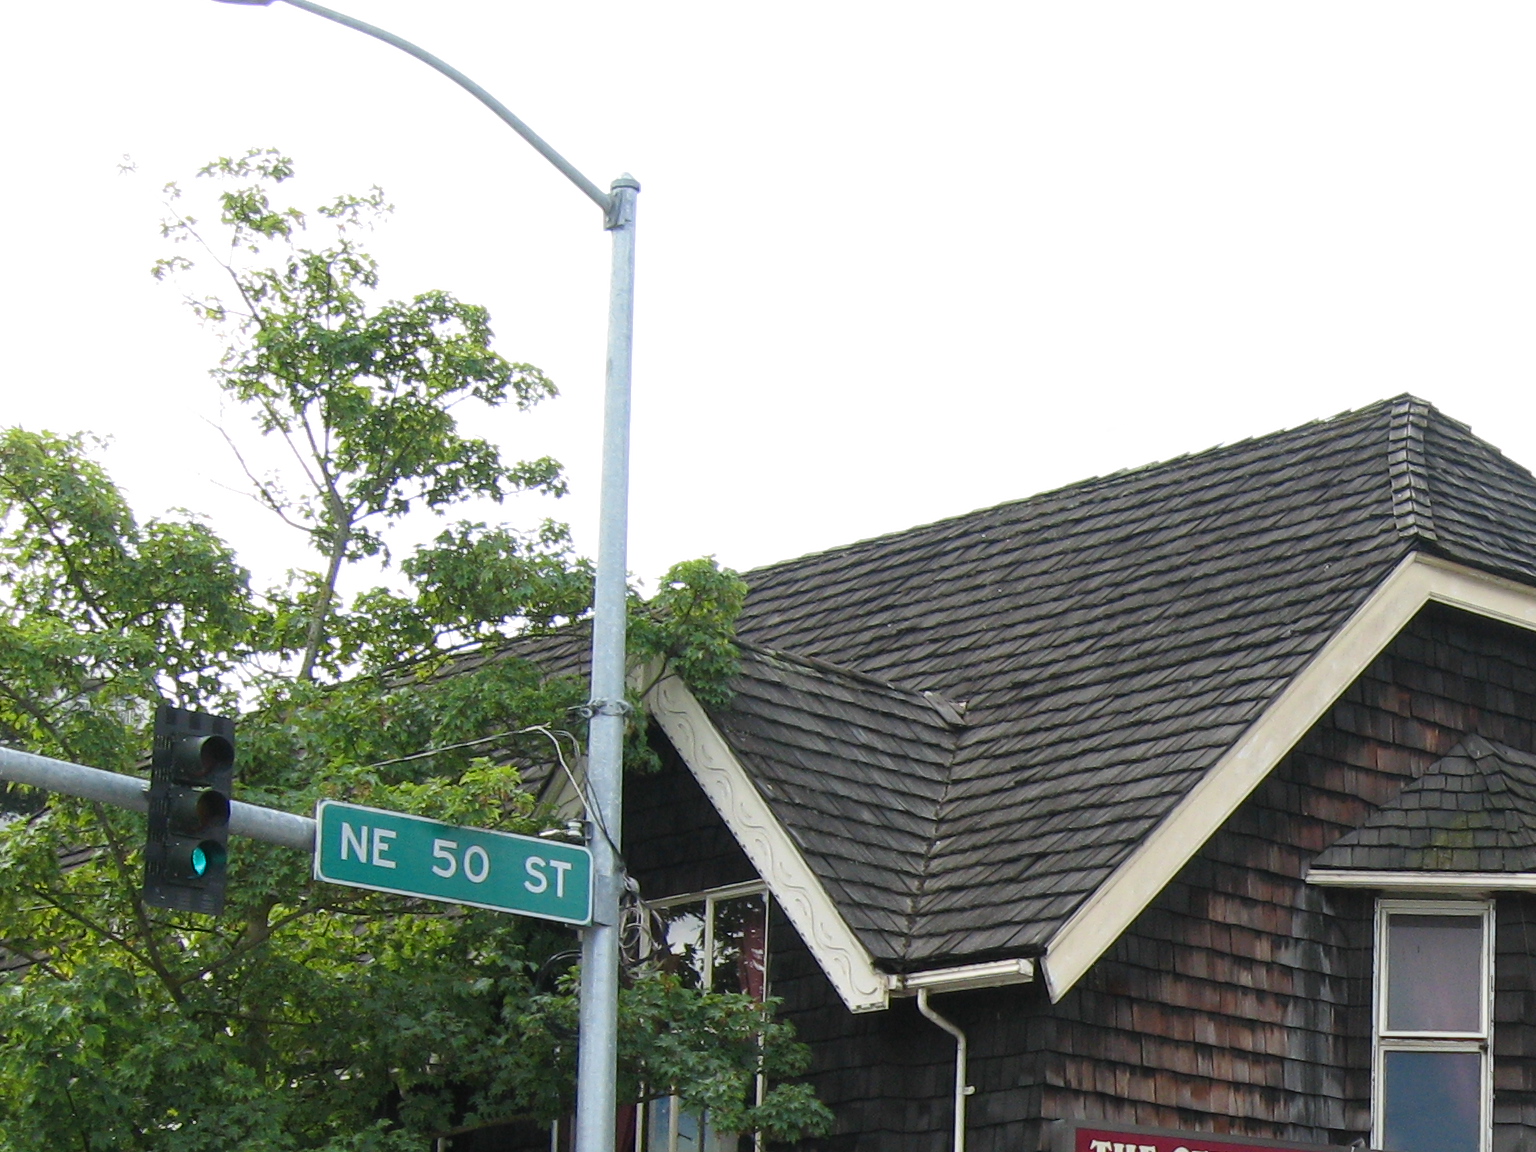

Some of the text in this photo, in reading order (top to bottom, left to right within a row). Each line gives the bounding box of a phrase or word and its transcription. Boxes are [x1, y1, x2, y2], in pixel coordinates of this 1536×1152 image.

[340, 822, 572, 898] NE 50 ST
